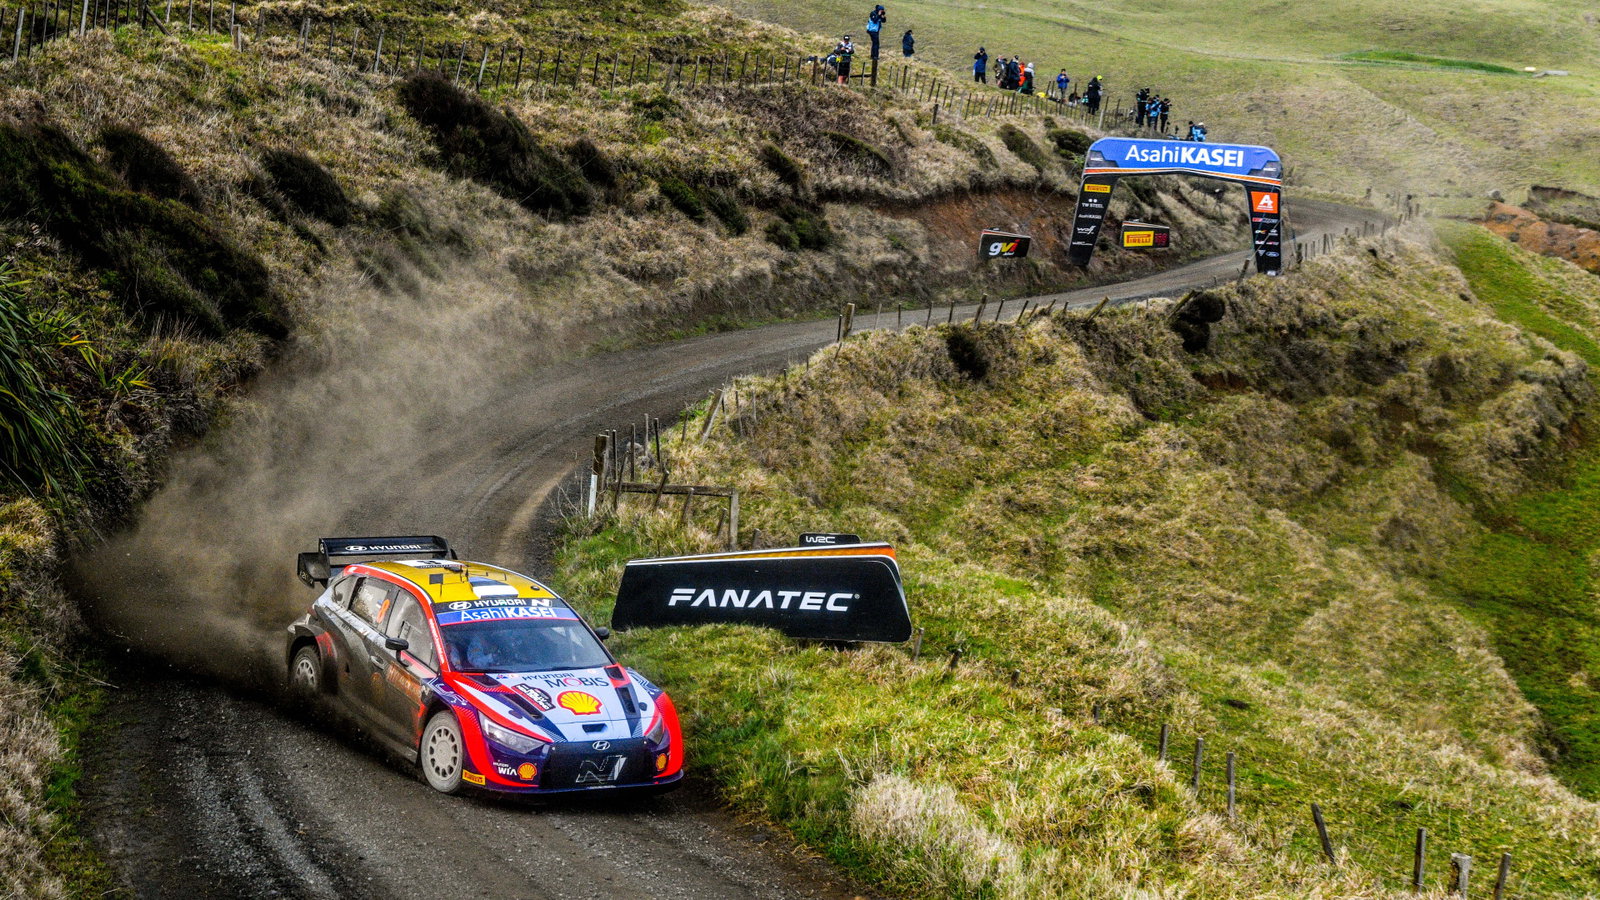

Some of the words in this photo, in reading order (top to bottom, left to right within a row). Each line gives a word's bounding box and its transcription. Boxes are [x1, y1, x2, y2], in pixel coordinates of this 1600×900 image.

[1125, 144, 1244, 167] AsahiKASEI
[1126, 234, 1152, 244] PIRELLI
[805, 535, 836, 544] WRC
[474, 598, 527, 608] HYUNDAI
[461, 606, 558, 622] AsahiKASEI
[521, 672, 575, 681] HYUNDAI
[544, 677, 610, 689] MOBIS
